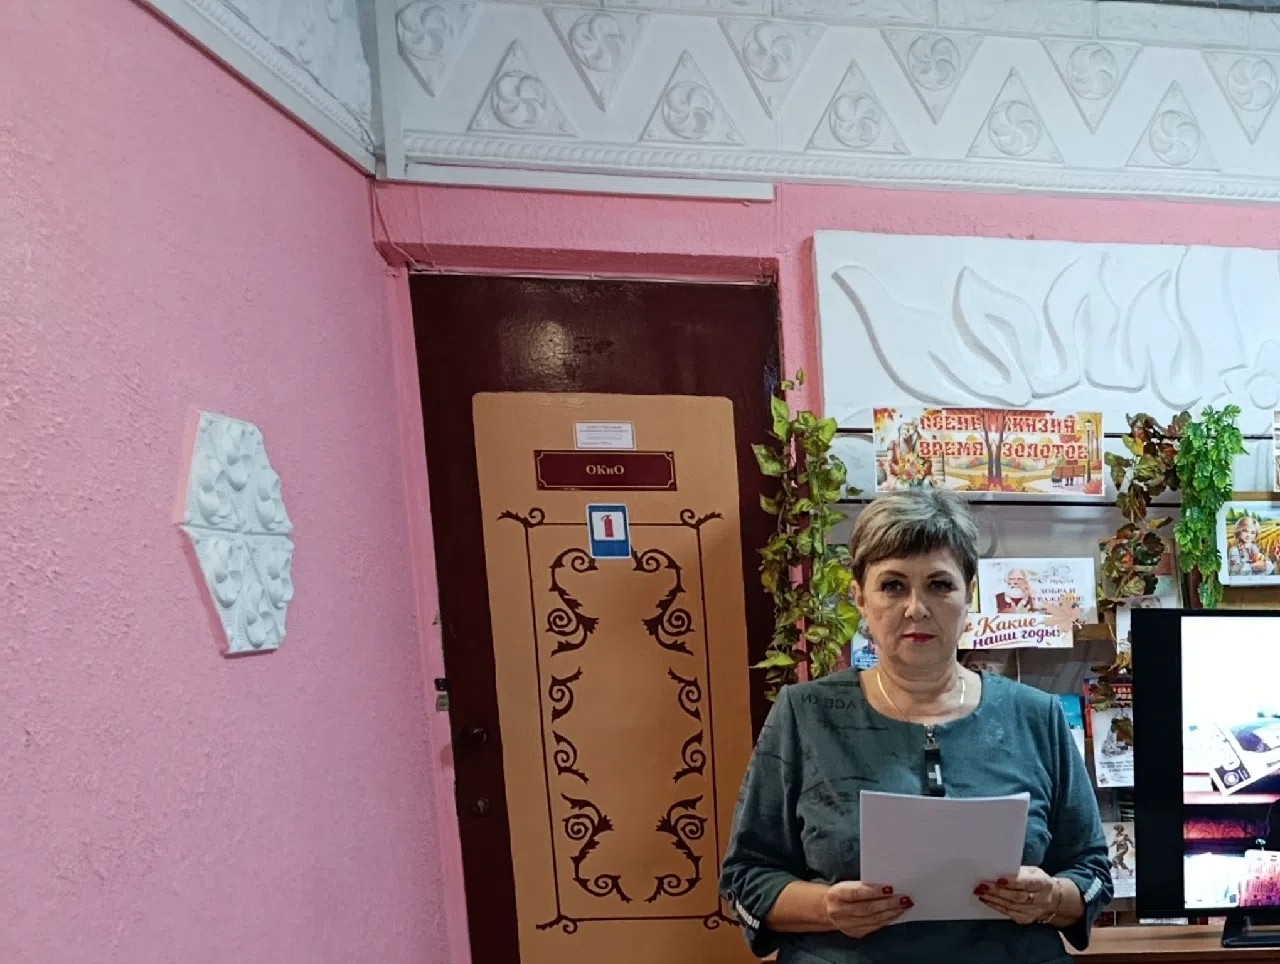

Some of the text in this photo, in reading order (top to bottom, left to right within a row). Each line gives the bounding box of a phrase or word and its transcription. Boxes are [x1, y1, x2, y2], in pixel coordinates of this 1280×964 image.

[918, 440, 1089, 460] ВРЕМЯ ЗОЛОТОЕ
[975, 616, 1037, 637] Какие
[972, 631, 1018, 650] наши
